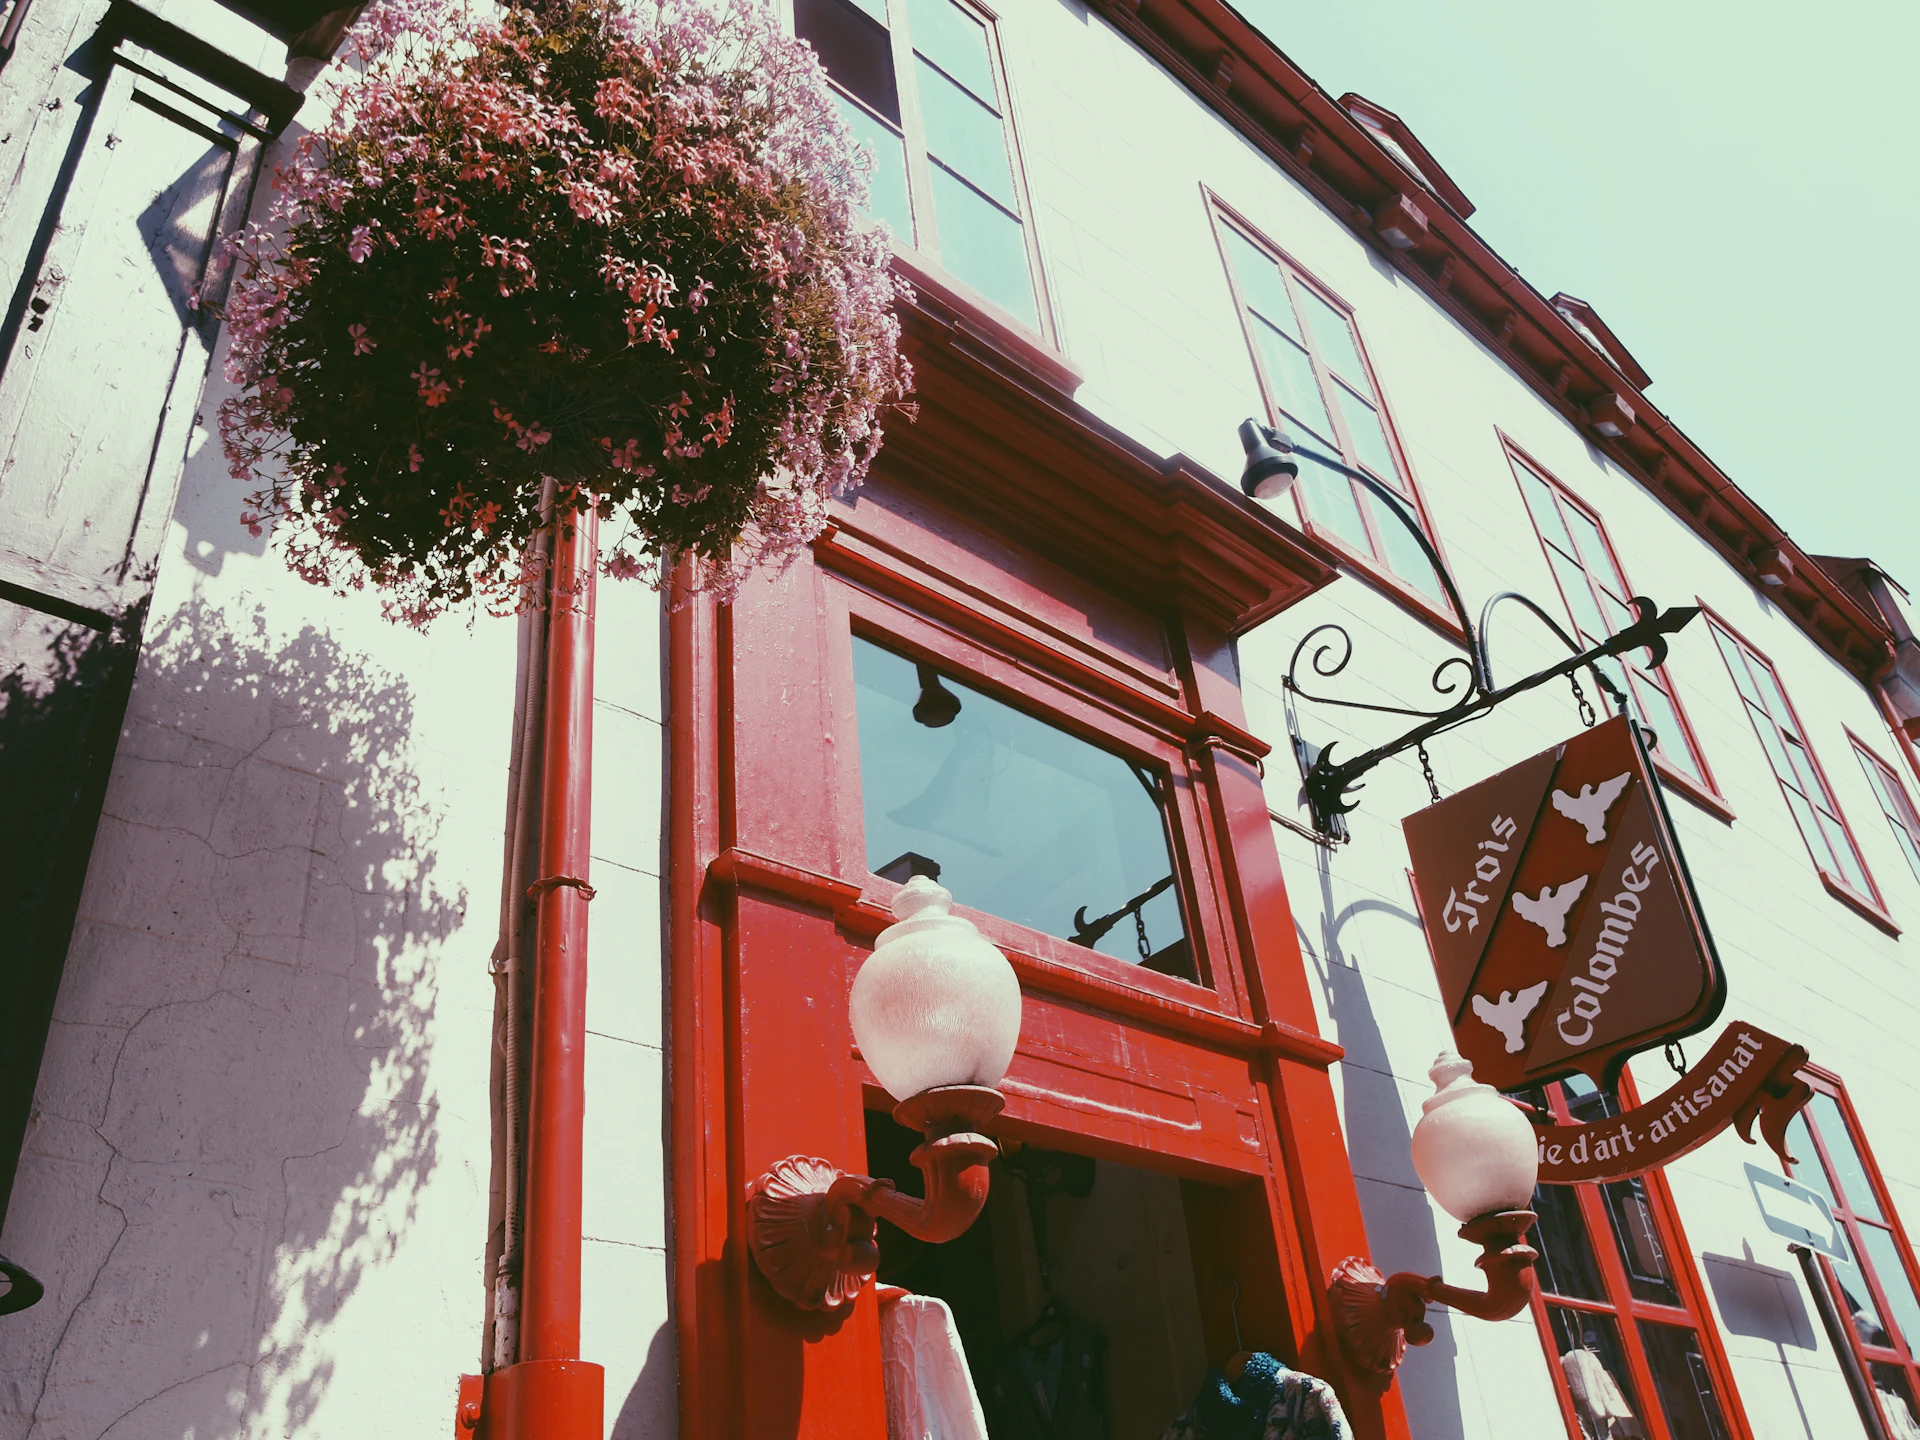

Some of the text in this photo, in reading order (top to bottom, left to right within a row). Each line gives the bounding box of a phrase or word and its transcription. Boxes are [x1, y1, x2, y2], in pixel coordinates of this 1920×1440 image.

[1442, 814, 1518, 935] Trois
[1556, 840, 1660, 1046] Colombes
[1648, 1032, 1763, 1143] artisanat
